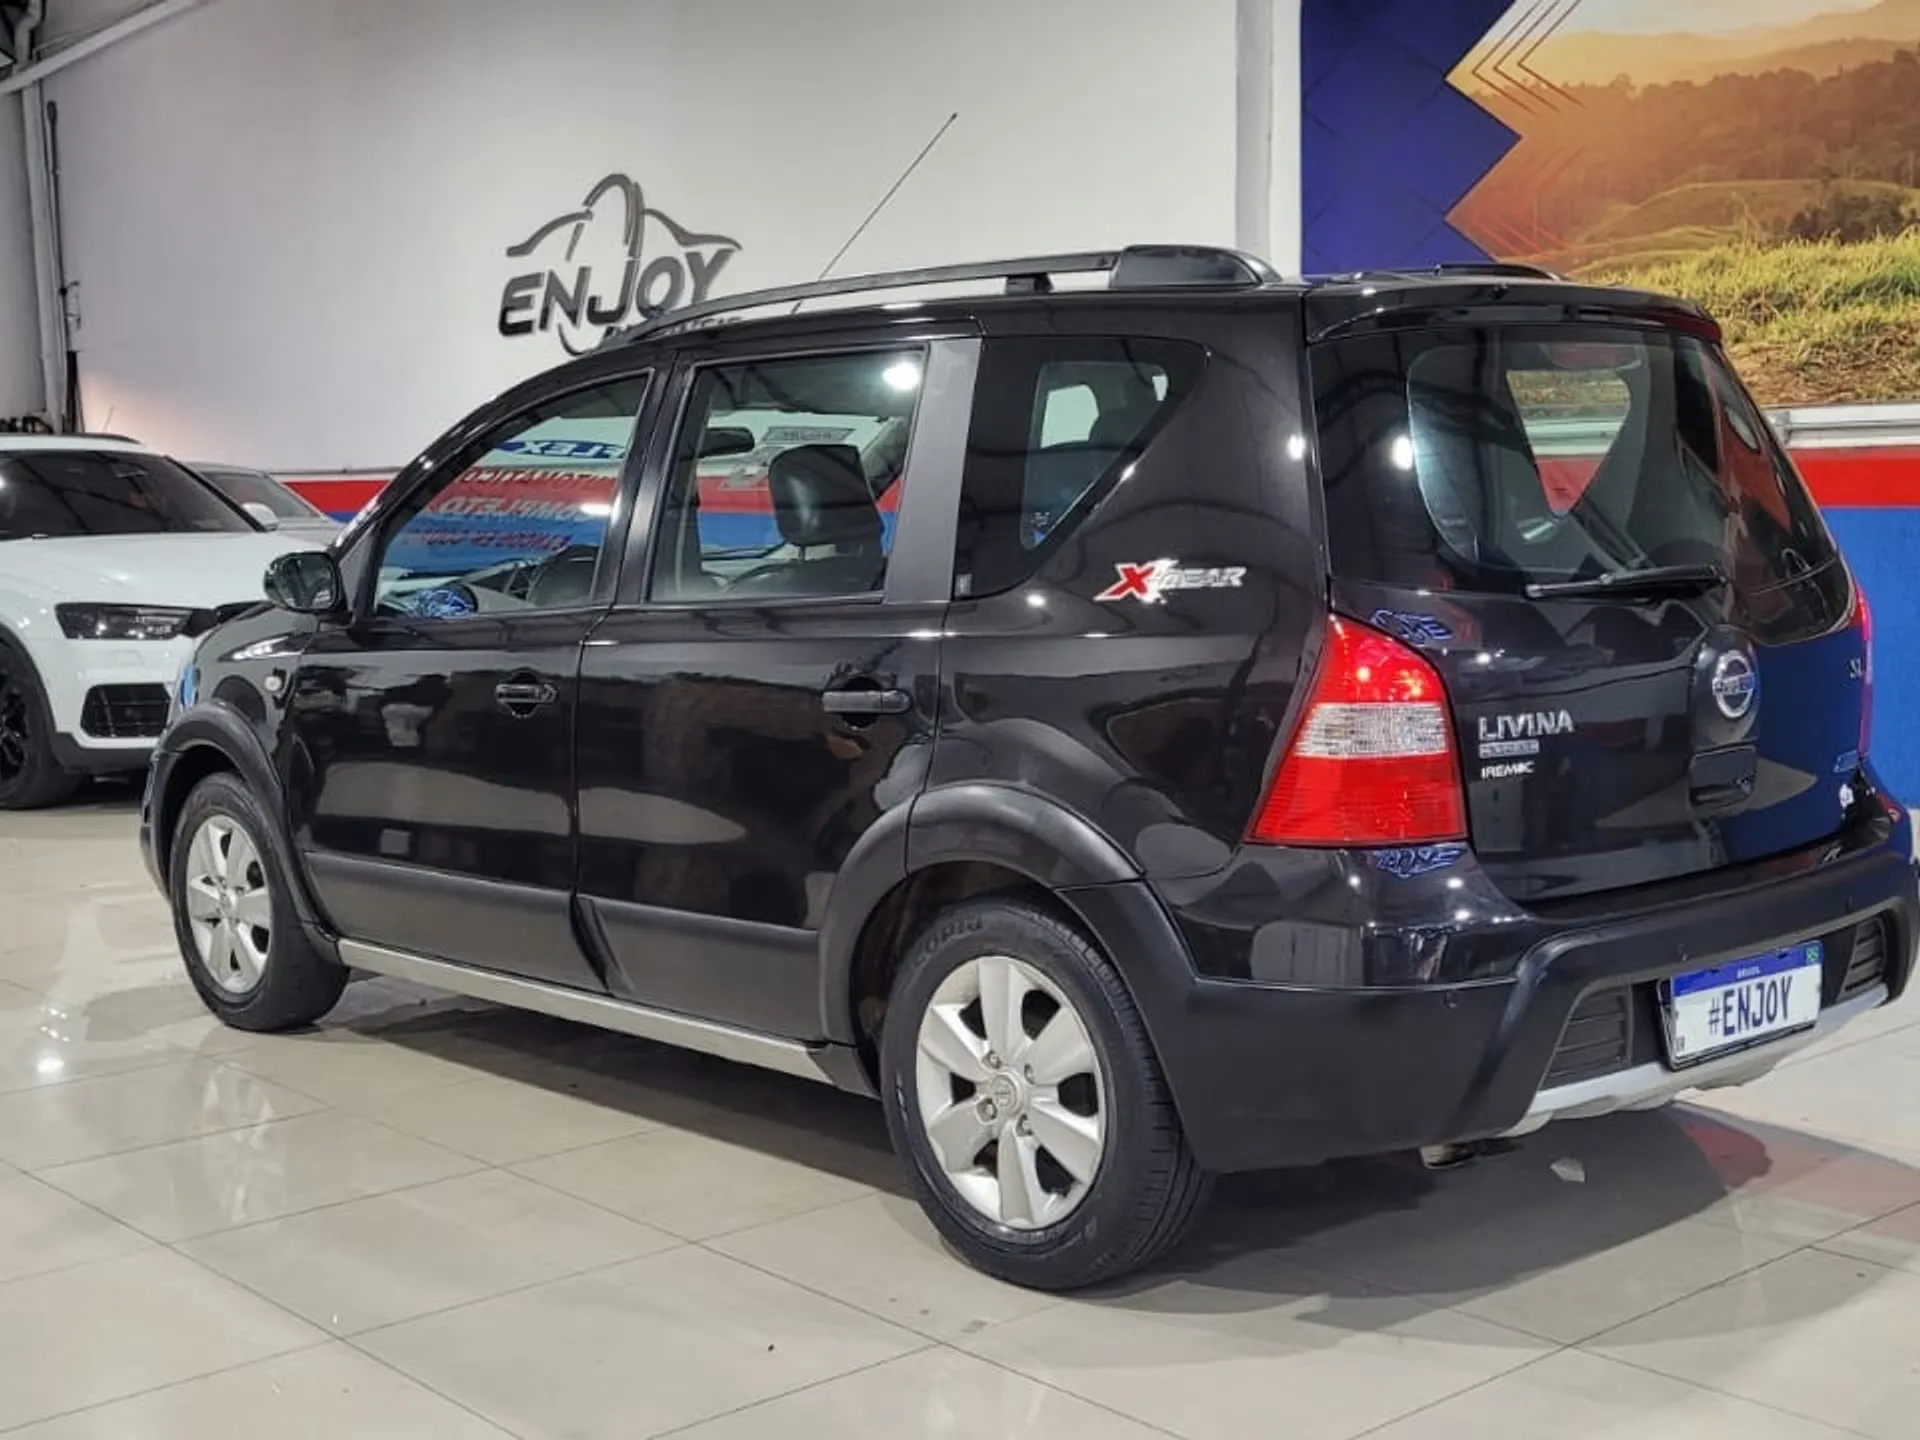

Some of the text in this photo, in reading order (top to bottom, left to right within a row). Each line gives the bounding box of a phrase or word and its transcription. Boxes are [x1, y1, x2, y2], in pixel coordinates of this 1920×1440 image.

[499, 247, 736, 337] ENJOY
[1479, 709, 1575, 741] LIVINA
[1708, 975, 1793, 1037] #ENJOY
